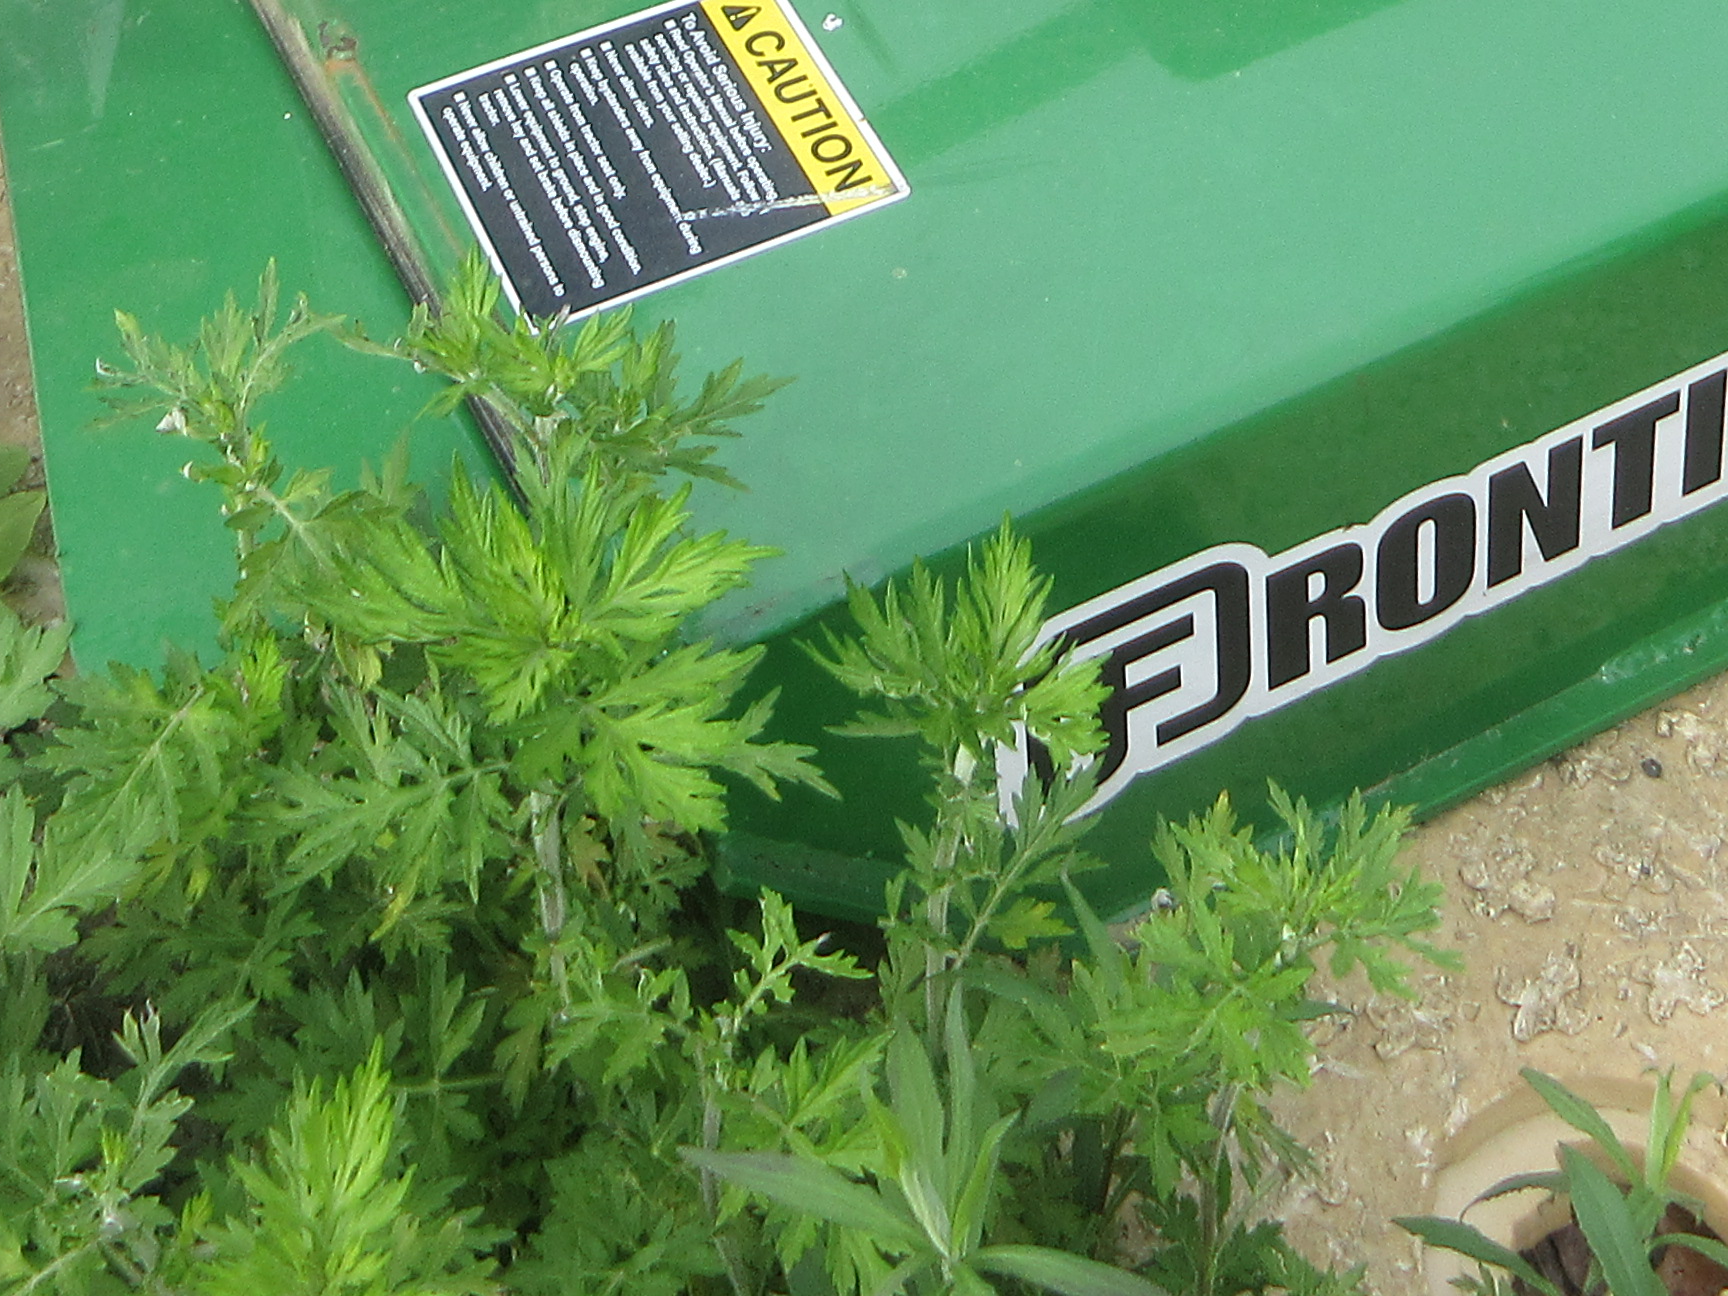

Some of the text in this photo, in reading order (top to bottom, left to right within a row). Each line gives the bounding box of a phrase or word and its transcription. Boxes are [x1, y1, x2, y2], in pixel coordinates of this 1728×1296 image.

[681, 12, 772, 153] To Avoid Serious Injury:
[744, 30, 872, 193] CAUTION
